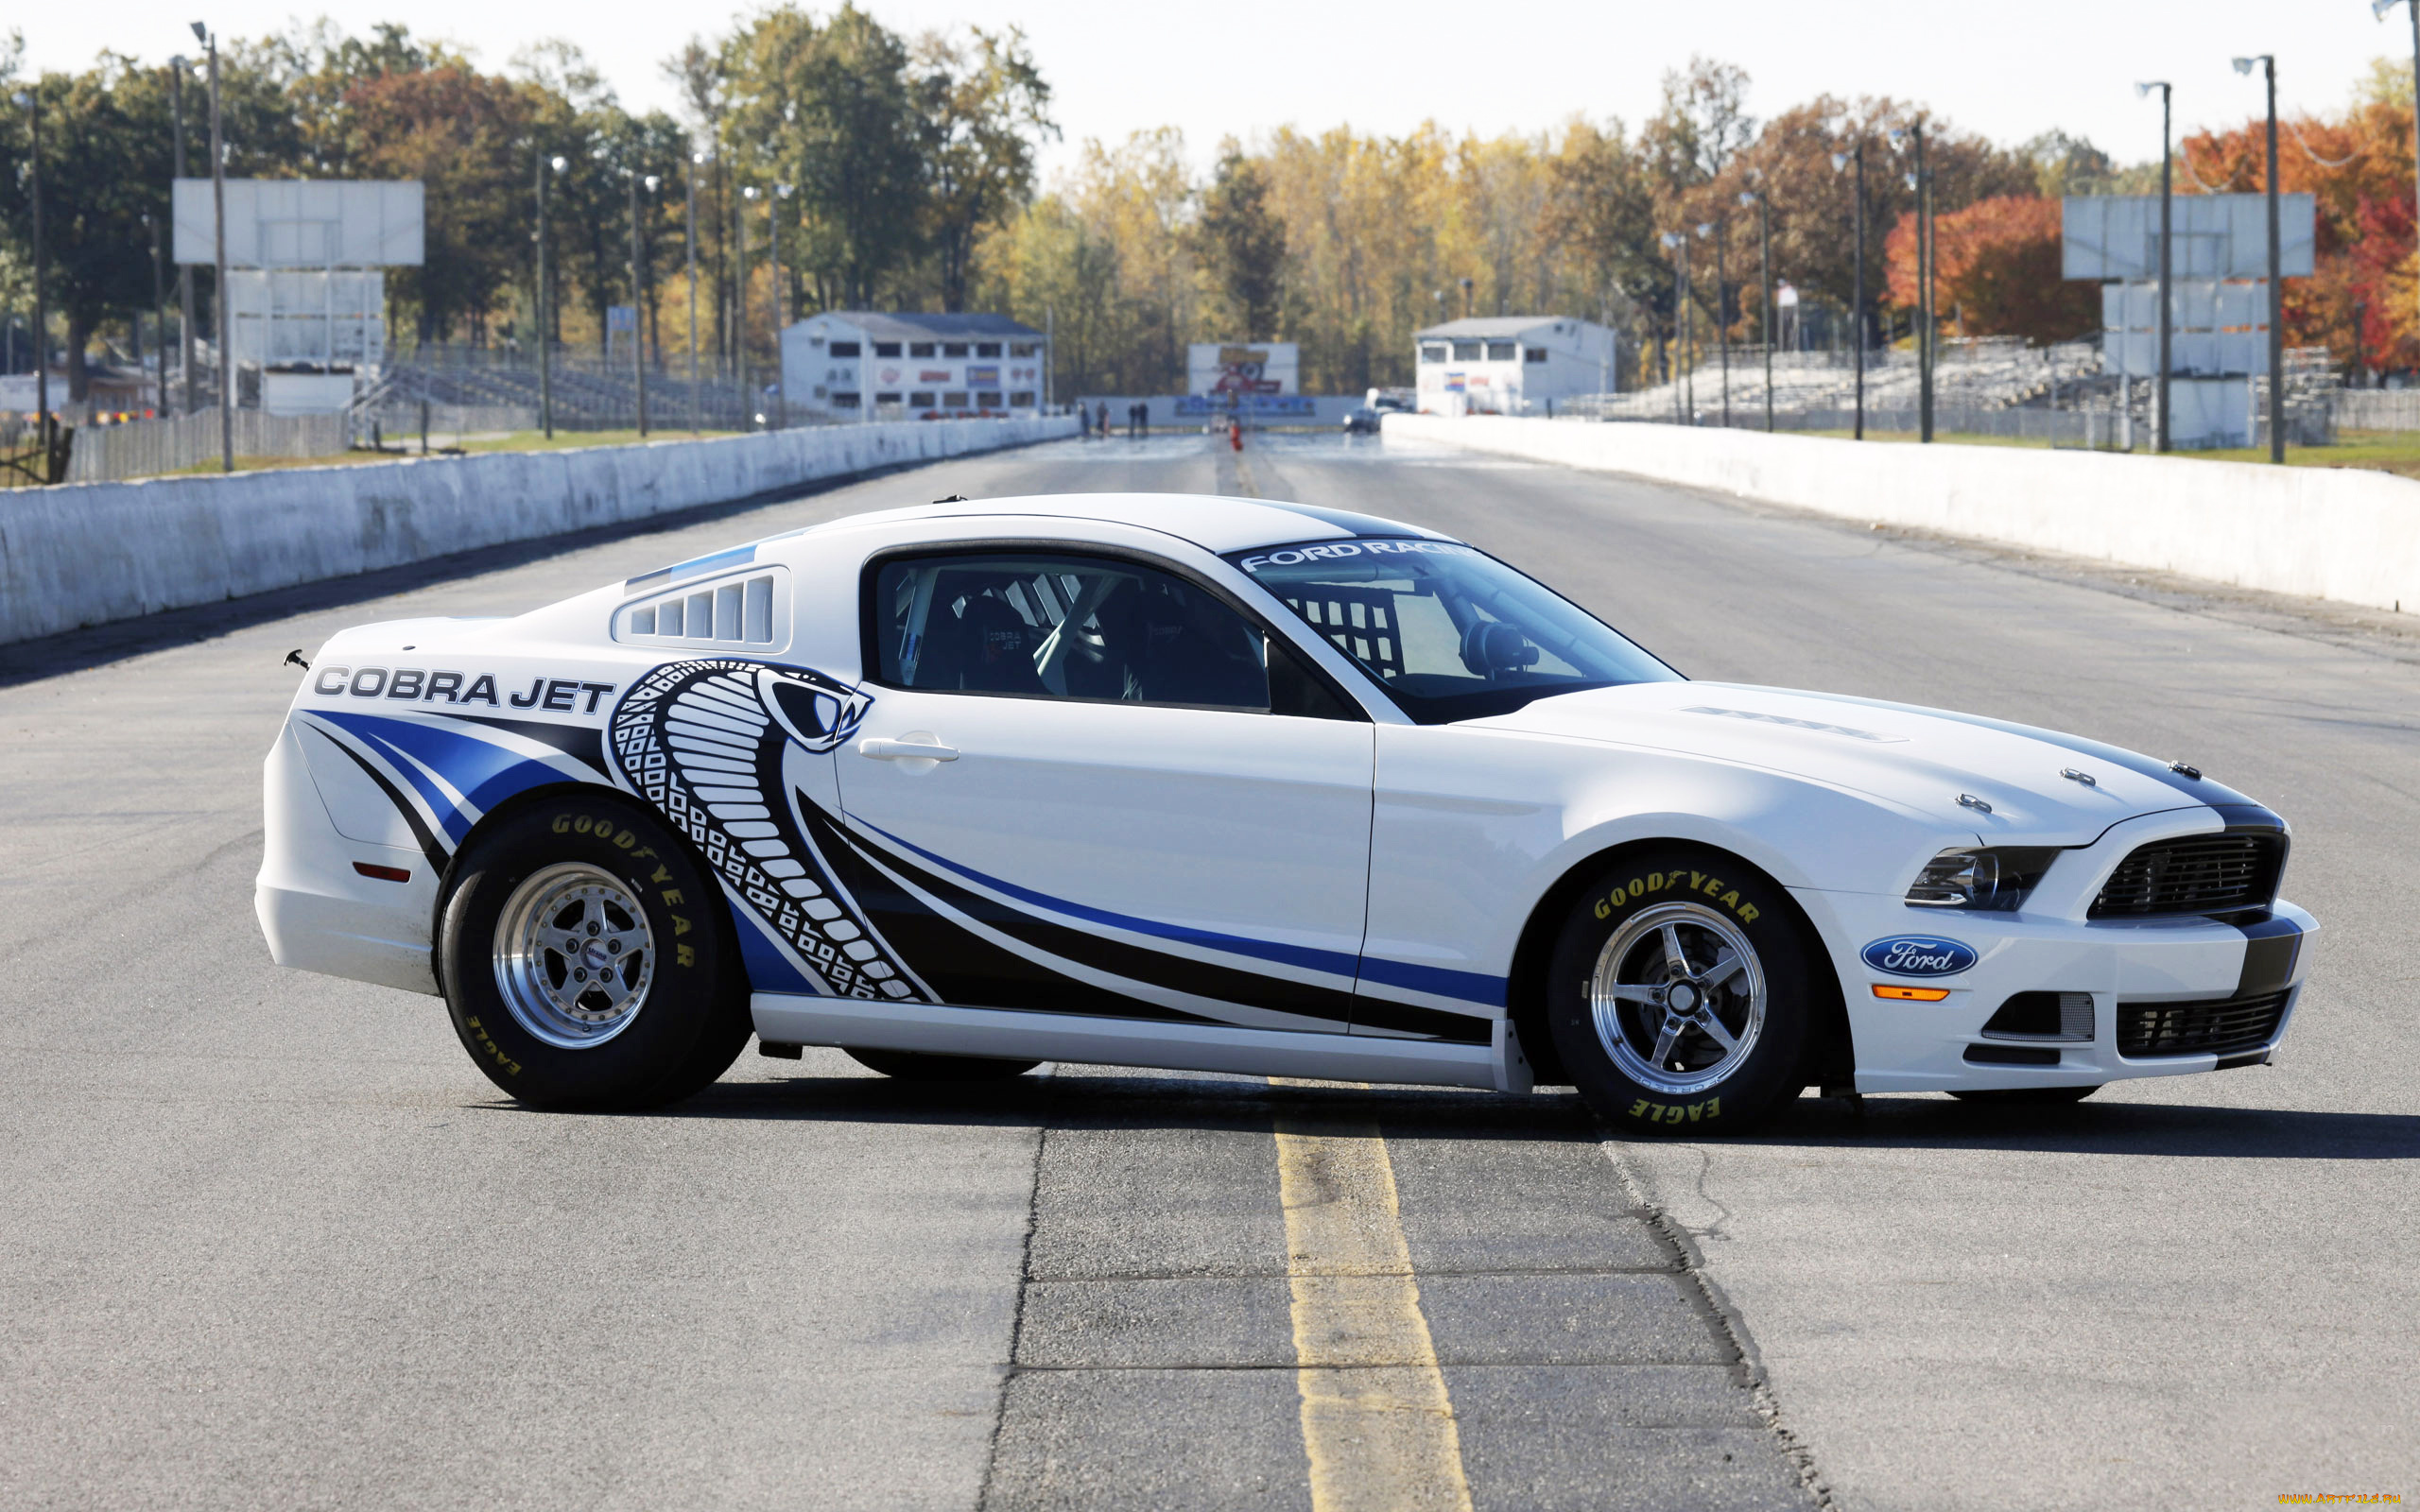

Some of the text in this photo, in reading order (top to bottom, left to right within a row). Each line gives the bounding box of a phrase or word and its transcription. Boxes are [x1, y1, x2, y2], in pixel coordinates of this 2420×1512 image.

[1240, 543, 1361, 573] FORD
[1002, 641, 1022, 650] JET
[314, 665, 617, 715] COBRA JET
[552, 814, 696, 969] GOODYEAR
[1594, 869, 1760, 925] GOODYEAR
[1884, 941, 1955, 971] Ford
[466, 1015, 522, 1075] EAGLE
[1628, 1096, 1720, 1125] EAGLE
